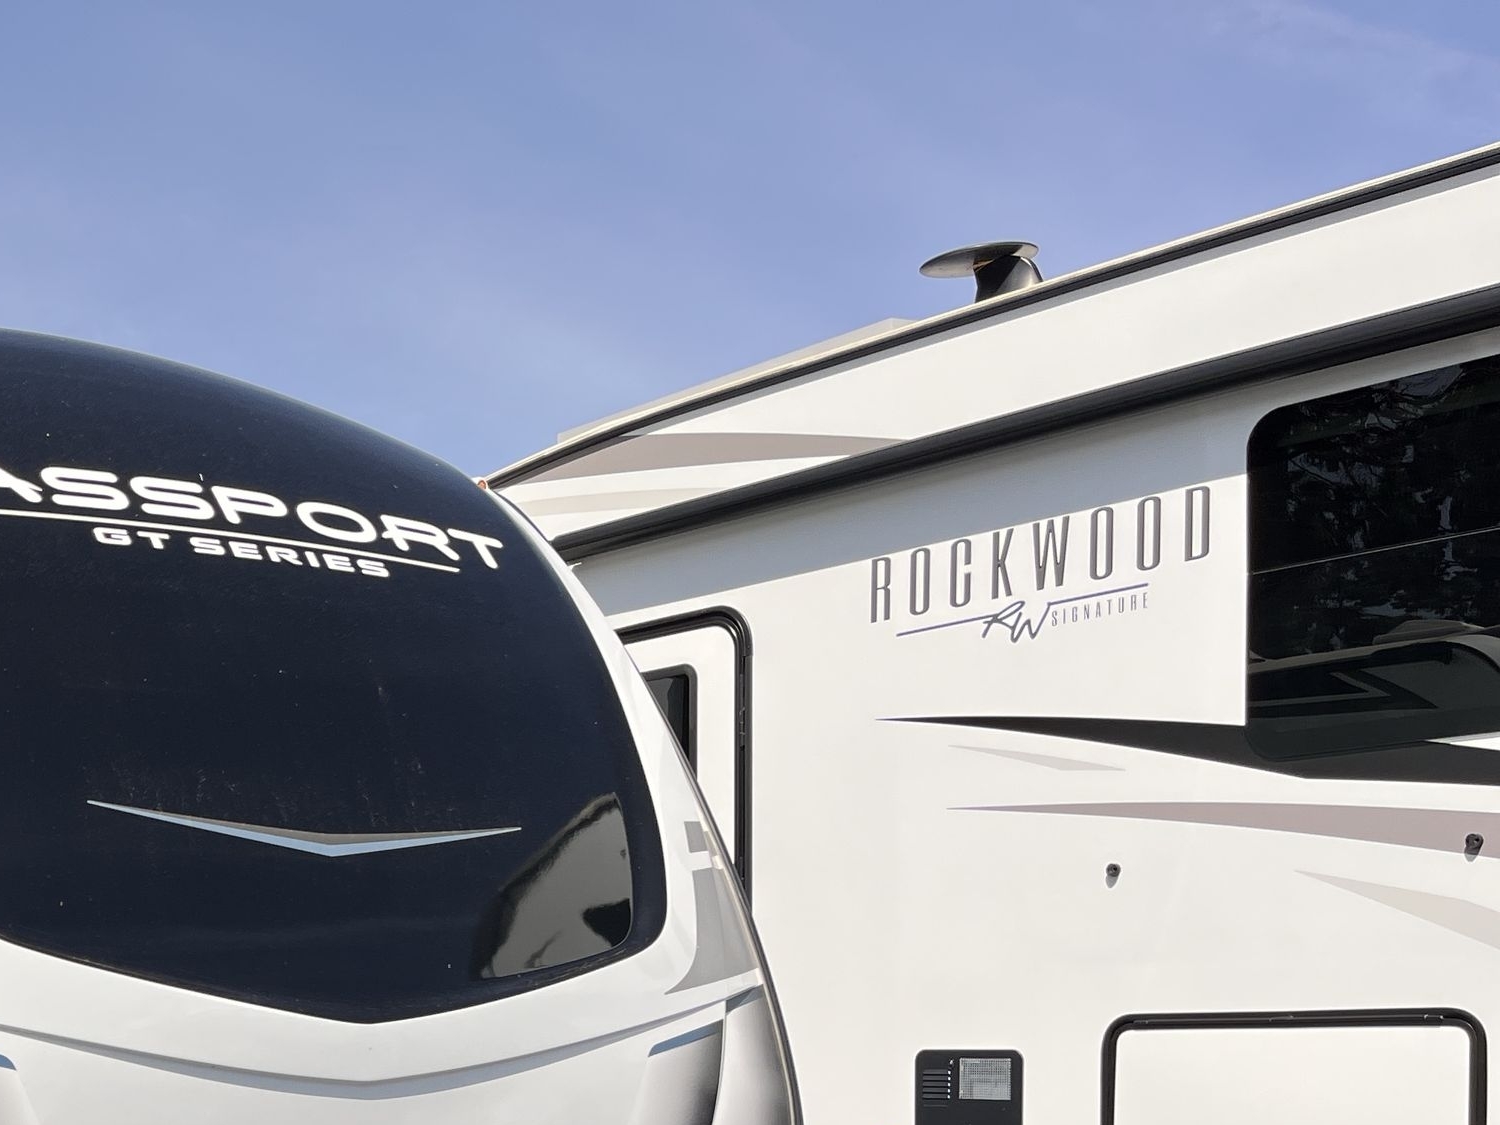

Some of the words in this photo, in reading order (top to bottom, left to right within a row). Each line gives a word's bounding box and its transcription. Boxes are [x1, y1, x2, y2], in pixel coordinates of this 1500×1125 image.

[91, 526, 171, 551] GT
[190, 536, 390, 578] SERIES
[870, 485, 1211, 623] ROCKWOOD
[1051, 592, 1149, 627] SIGNATURE
